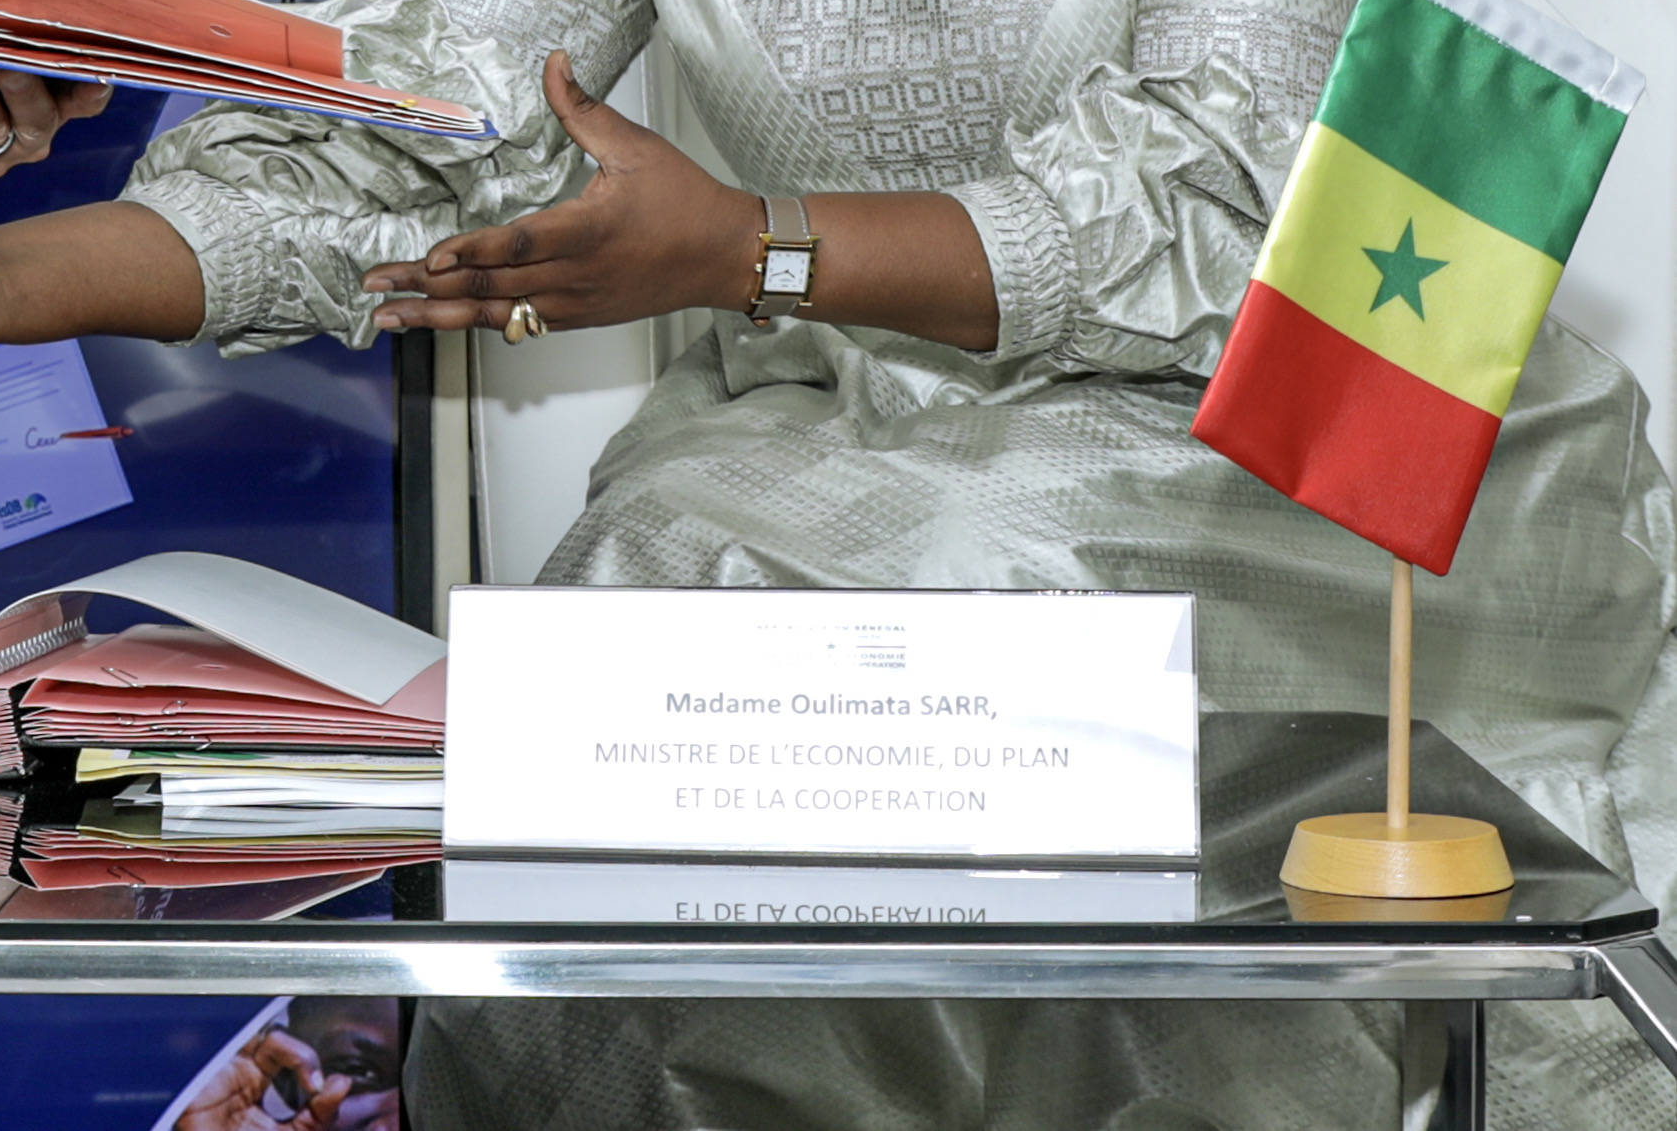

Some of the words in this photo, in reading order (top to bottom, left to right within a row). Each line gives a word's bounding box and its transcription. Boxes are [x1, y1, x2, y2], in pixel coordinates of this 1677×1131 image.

[666, 692, 781, 714] Madame
[791, 693, 911, 715] Oulimata
[920, 695, 998, 720] SARR,
[595, 742, 718, 764] MINISTRE
[730, 743, 761, 764] DE
[954, 746, 991, 768] DU
[1002, 746, 1069, 768] PLAN
[676, 787, 705, 808] ET
[715, 787, 746, 809] DE
[757, 788, 786, 809] LA
[794, 788, 986, 812] COOPERATION
